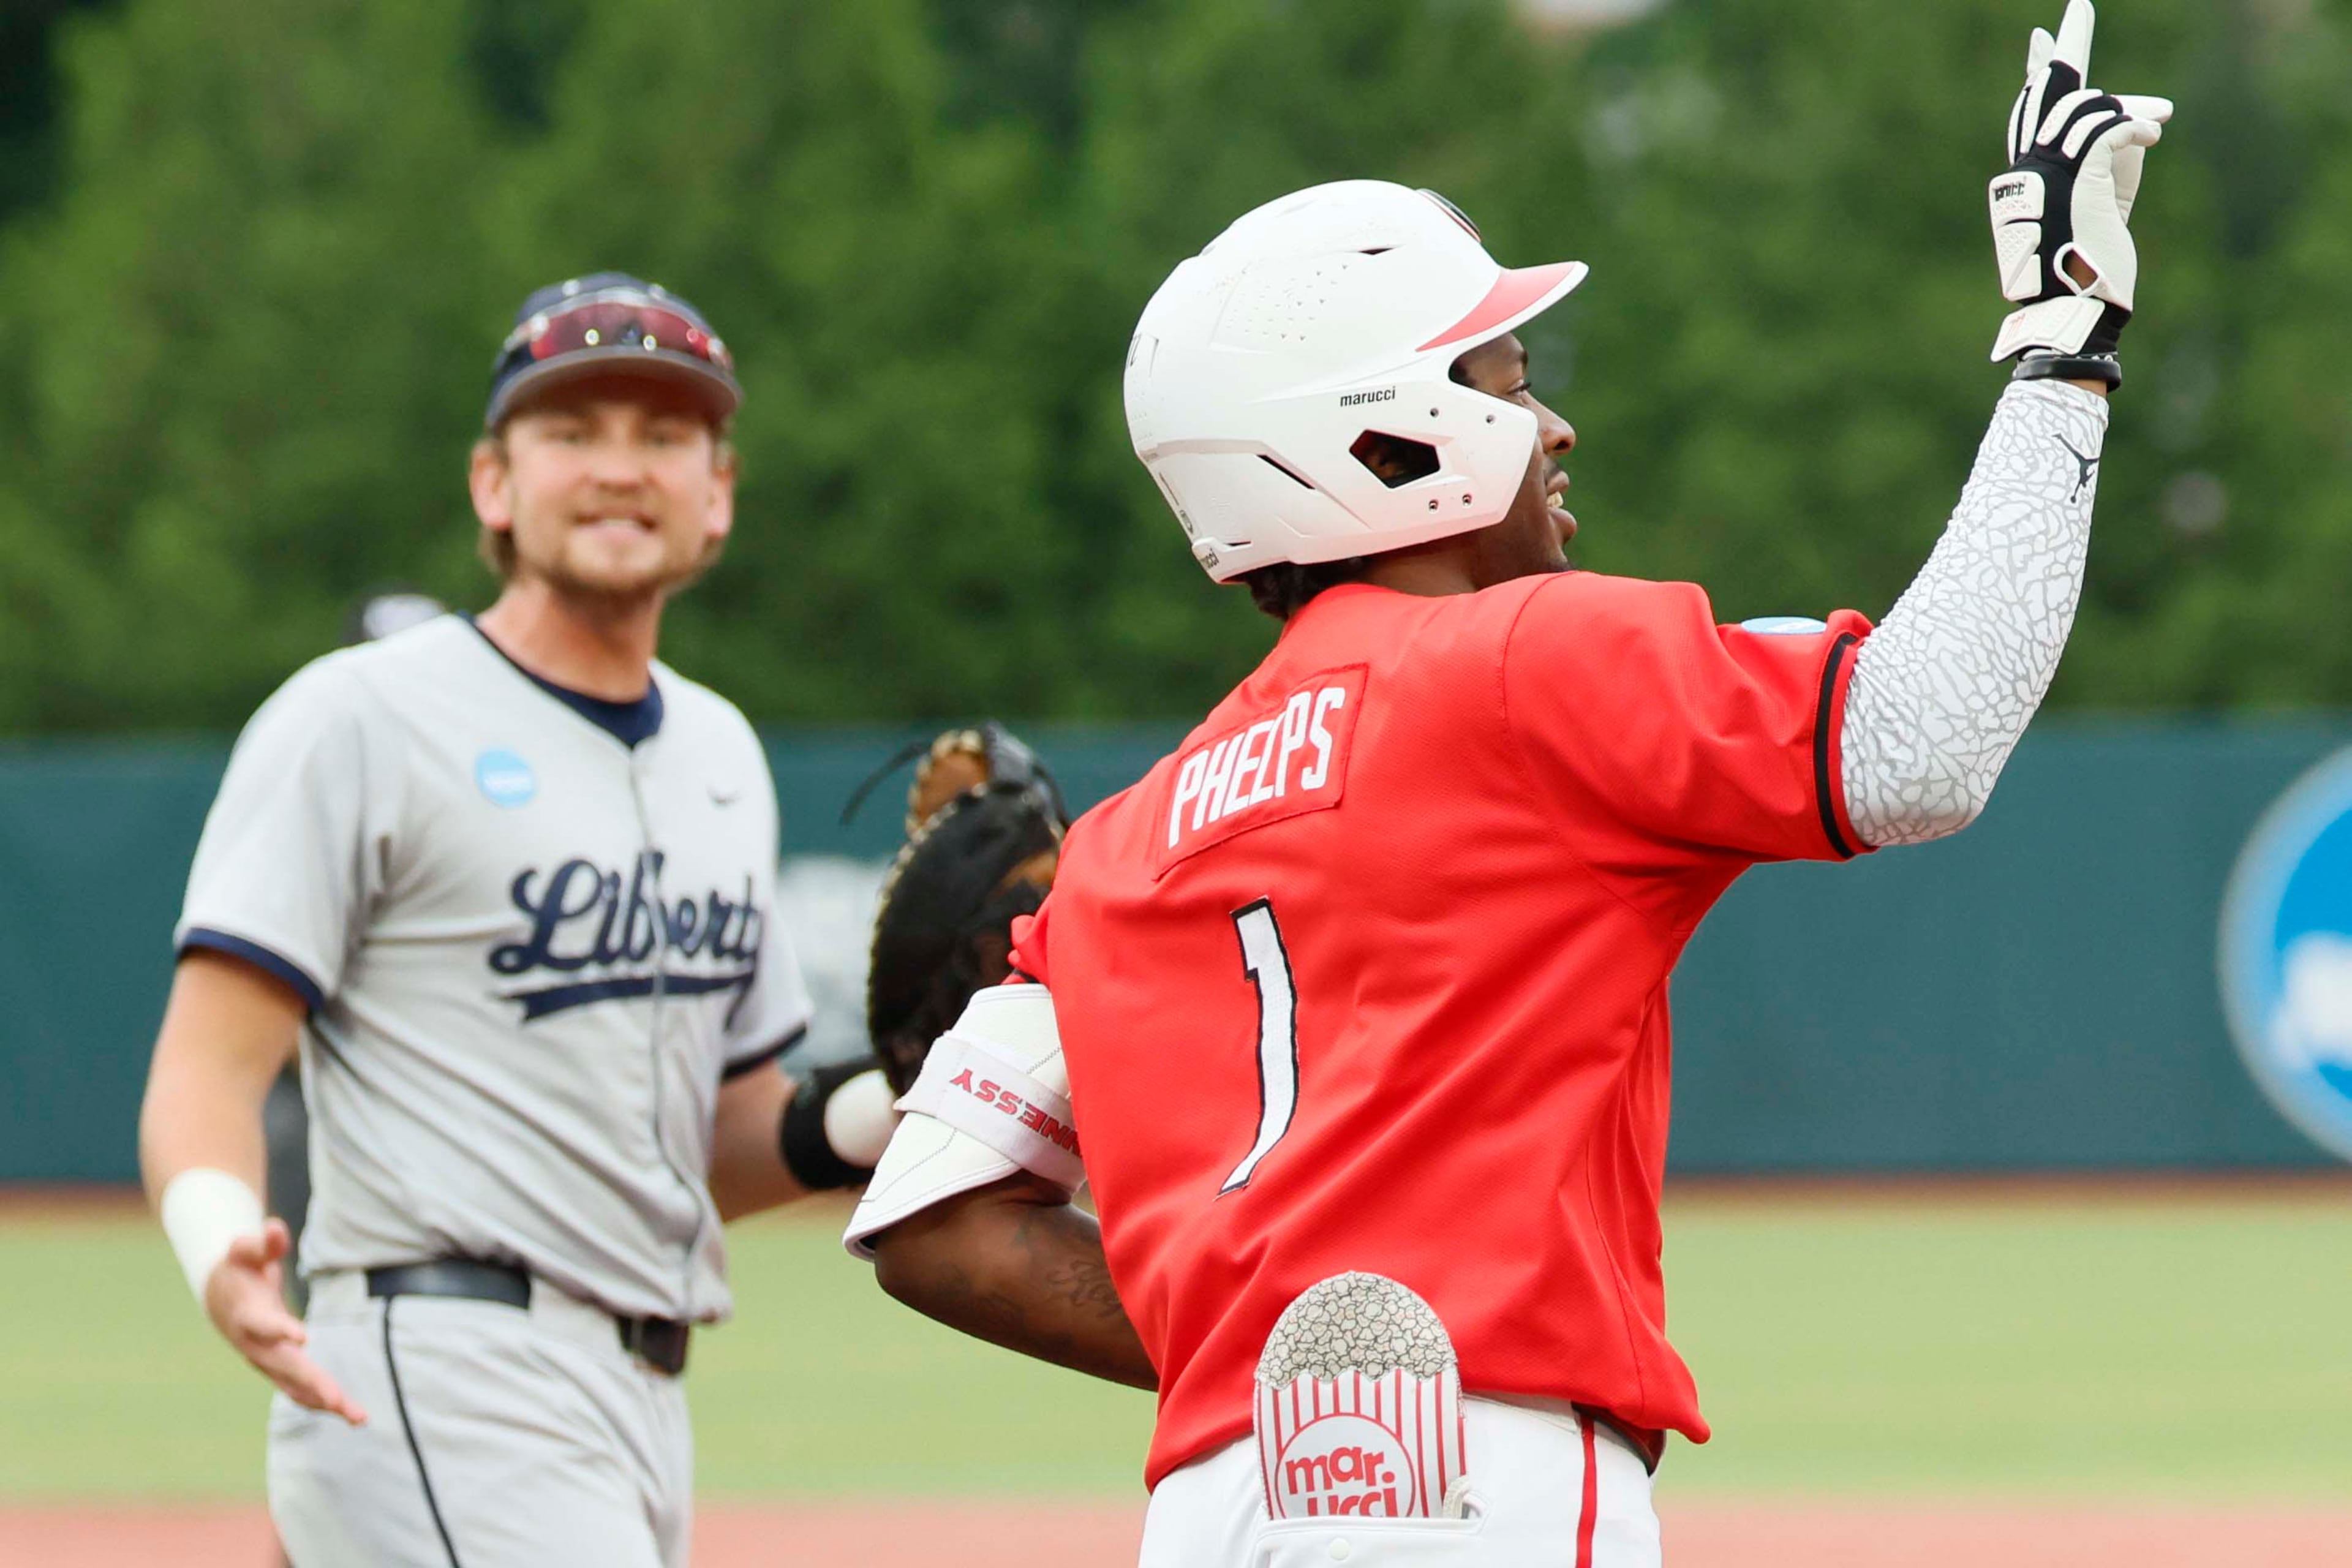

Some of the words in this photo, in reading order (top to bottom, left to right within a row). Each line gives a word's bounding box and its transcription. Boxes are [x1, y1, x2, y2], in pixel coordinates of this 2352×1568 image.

[1340, 385, 1396, 407] marucci
[1167, 687, 1346, 850] PHELPS
[1213, 895, 1300, 1201] 1
